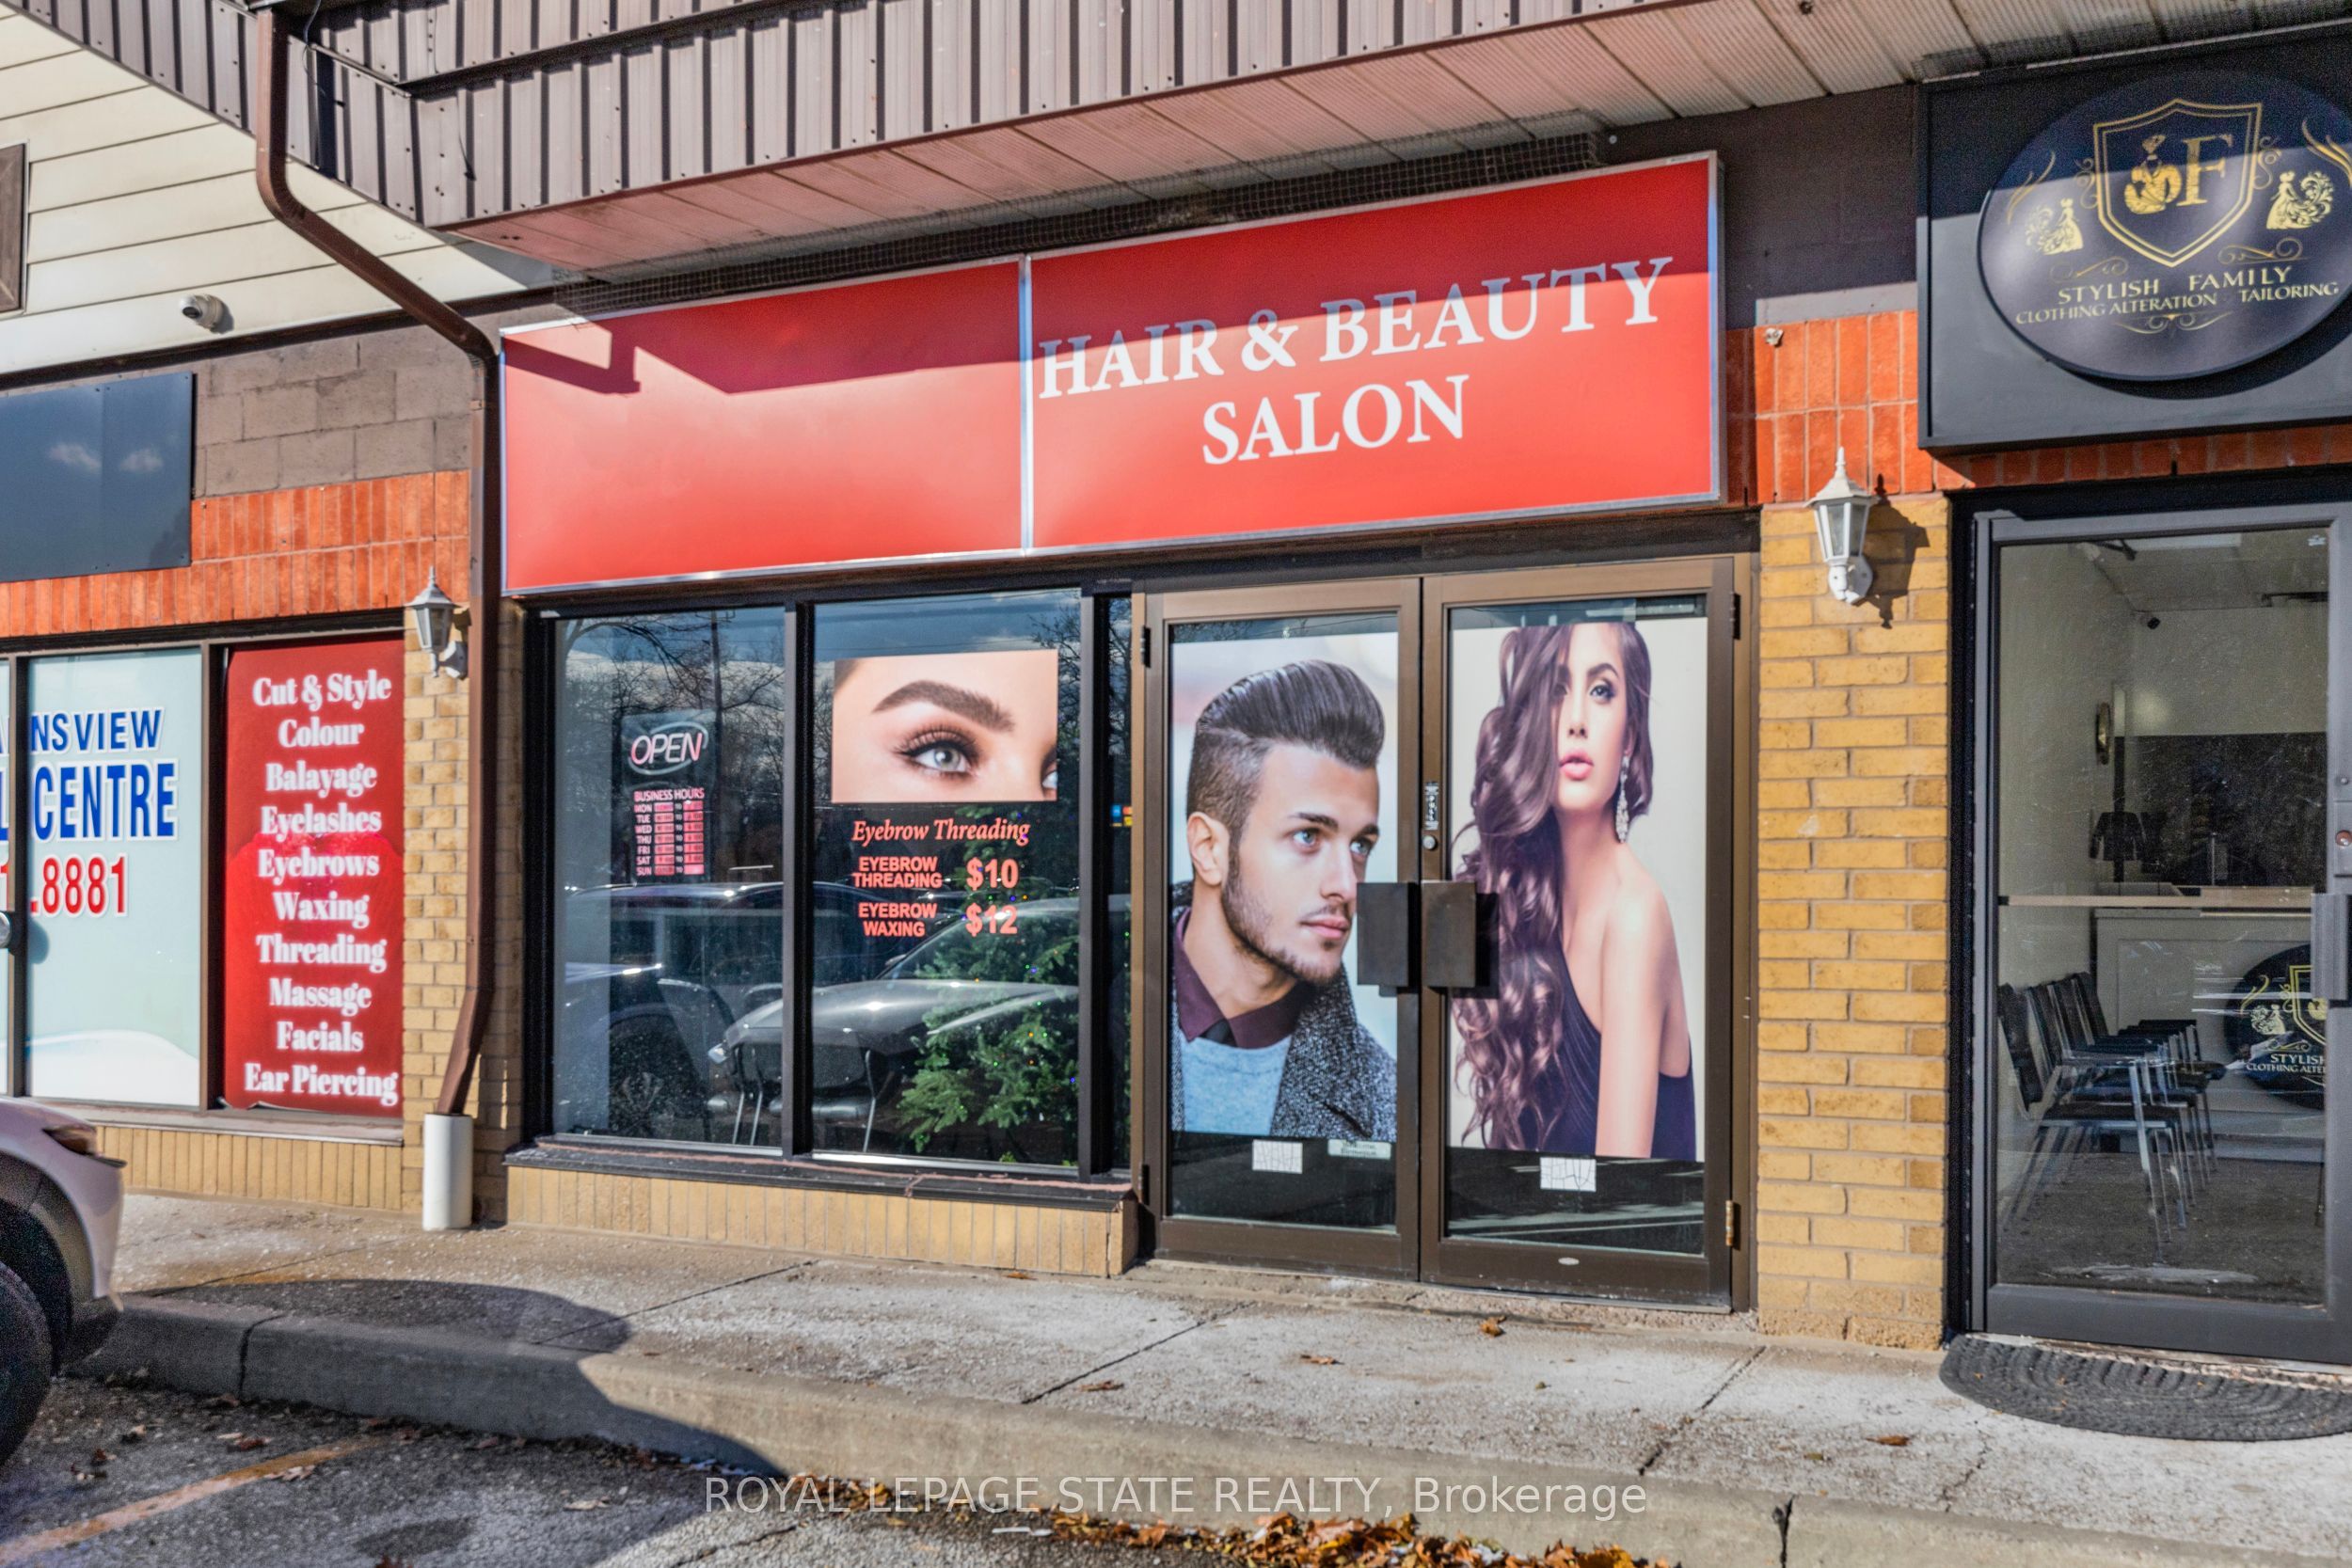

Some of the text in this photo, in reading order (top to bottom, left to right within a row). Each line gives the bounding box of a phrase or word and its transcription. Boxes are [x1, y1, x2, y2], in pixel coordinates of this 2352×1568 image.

[2058, 264, 2292, 305] STYLISH FAMILY
[2015, 282, 2340, 325] CLOTHING ALTERATION TAILORING
[1039, 256, 1674, 399] HAIR & BEAUTY
[1202, 374, 1470, 466] SALON
[252, 669, 392, 712] Cut & Style
[278, 715, 365, 748] Colour
[630, 732, 703, 766] OPEN
[265, 759, 378, 799] Balayage
[633, 787, 705, 802] BUSINESS HOURS
[34, 763, 177, 840] CENTRE
[261, 802, 383, 843] Eyelashes
[851, 817, 1031, 847] Eyebrow Threading
[636, 835, 652, 845] THU
[637, 846, 651, 855] FRI
[258, 845, 381, 886] Eyebrows
[636, 856, 651, 865] SAT
[636, 866, 652, 877] SUN
[858, 856, 939, 872] EYEBROW
[966, 857, 1019, 891] $10
[852, 873, 943, 888] THREADING
[272, 891, 370, 929] Waxing
[858, 902, 938, 919] EYEBROW
[965, 903, 1018, 937] $12
[863, 921, 926, 937] WAXING
[256, 932, 388, 974] Threading
[269, 977, 373, 1017] Massage
[277, 1021, 364, 1053] Facials
[245, 1062, 399, 1106] Ear Piercing
[2246, 1062, 2299, 1072] CLOTHING
